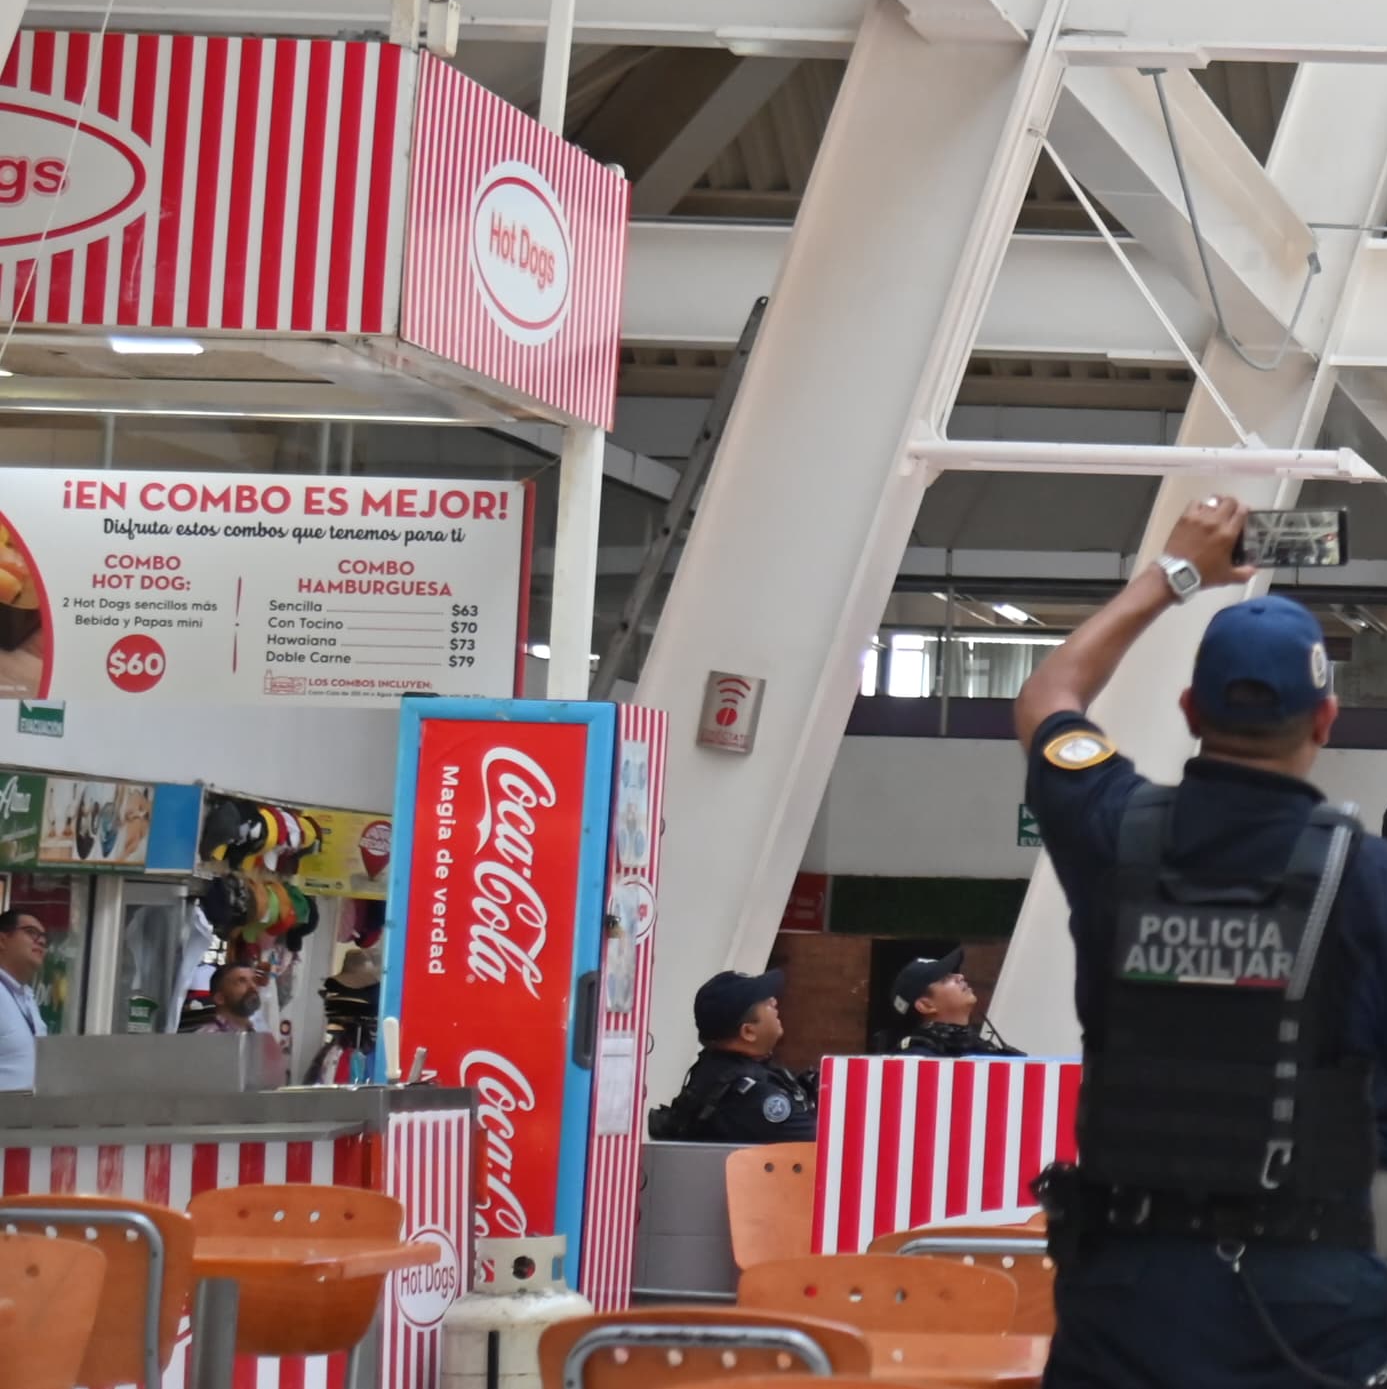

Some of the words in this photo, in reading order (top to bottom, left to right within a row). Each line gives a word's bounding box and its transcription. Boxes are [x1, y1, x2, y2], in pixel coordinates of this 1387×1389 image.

[489, 208, 516, 266] Hot
[519, 225, 555, 290] Dogs
[63, 480, 127, 510] ¡EN
[139, 482, 291, 514] COMBO
[304, 486, 348, 516] ES
[361, 488, 508, 520] MEJOR!
[103, 518, 172, 540] Disfruta
[176, 522, 220, 536] estos
[224, 522, 290, 538] combos
[292, 526, 326, 544] que
[329, 525, 400, 541] tenemos
[404, 528, 448, 546] para
[451, 527, 465, 543] ti
[104, 554, 181, 571] COMBO
[338, 559, 415, 575] COMBO
[92, 574, 135, 589] HOT
[141, 575, 192, 591] DOG:
[297, 578, 452, 596] HAMBURGUESA
[62, 597, 70, 608] 2
[73, 598, 95, 608] Hot
[99, 598, 131, 611] Dogs
[135, 600, 188, 611] sencillos
[191, 601, 218, 612] más
[269, 599, 323, 612] Sencilla
[451, 604, 478, 617] $63
[75, 615, 119, 626] Bebida
[123, 618, 131, 628] y
[134, 616, 173, 629] Papas
[177, 617, 203, 628] mini
[268, 616, 295, 629] Con
[300, 617, 344, 630] Tocino
[450, 621, 477, 634] $70
[267, 634, 337, 646] Hawaiana
[449, 638, 476, 651] $73
[109, 649, 165, 678] $60
[265, 650, 306, 663] Doble
[310, 651, 352, 664] Carne
[448, 655, 475, 668] $79
[308, 678, 328, 687] LOS
[331, 678, 375, 689] COMBOS
[436, 765, 460, 841] Magia
[435, 849, 454, 879] de
[428, 888, 448, 974] verdad
[1139, 914, 1283, 950] POLICÍA
[1123, 944, 1294, 980] AUXILIAR
[400, 1272, 423, 1296] Hot
[425, 1268, 456, 1301] Dogs
